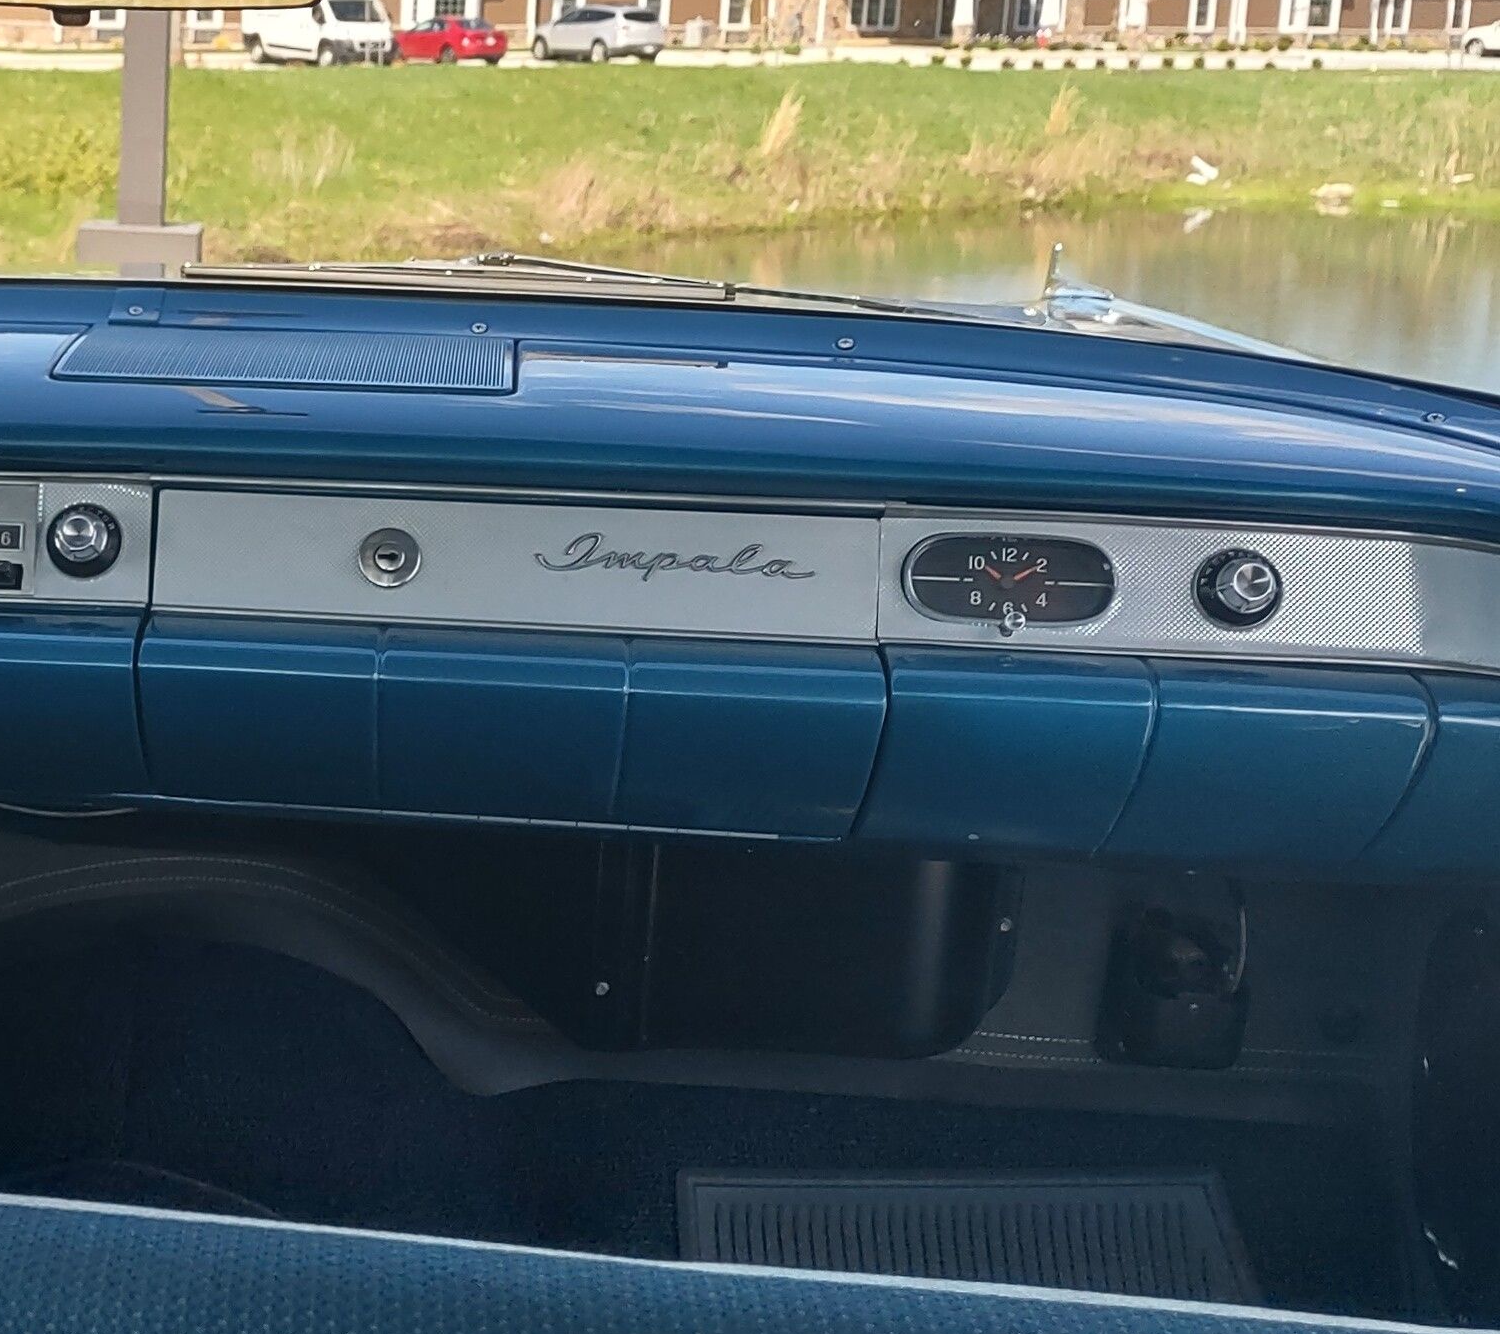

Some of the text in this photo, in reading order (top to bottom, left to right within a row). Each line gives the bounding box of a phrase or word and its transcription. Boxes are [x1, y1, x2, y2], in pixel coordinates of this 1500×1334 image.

[534, 532, 816, 582] Impala
[1002, 547, 1018, 562] 12
[968, 555, 1048, 573] 10 2
[970, 591, 1048, 607] 8 4
